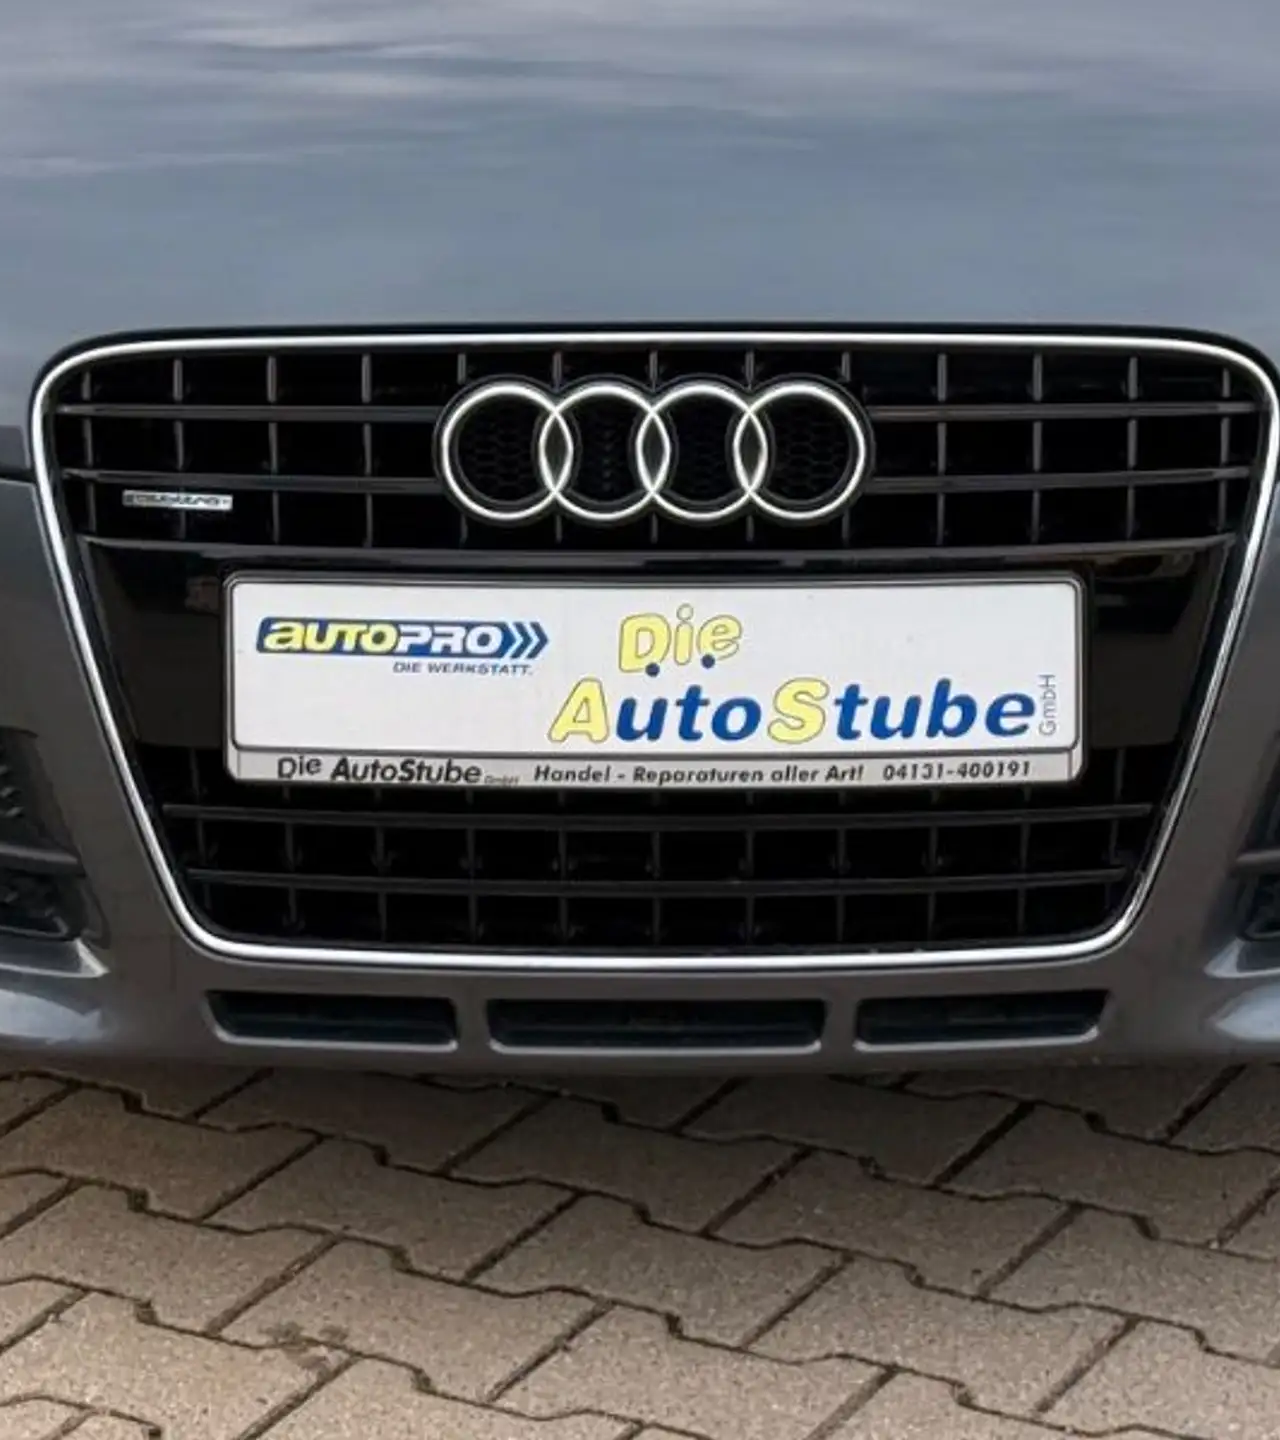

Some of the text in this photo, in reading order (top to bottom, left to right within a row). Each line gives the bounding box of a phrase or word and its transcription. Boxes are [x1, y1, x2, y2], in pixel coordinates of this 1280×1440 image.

[392, 661, 421, 674] DIE
[618, 603, 743, 674] Die
[548, 676, 1037, 745] AutoStube
[1038, 673, 1058, 737] GmbH
[277, 755, 322, 780] Die
[330, 756, 483, 785] AutoStube
[534, 764, 611, 783] Handel
[632, 765, 764, 786] Reparaturen
[770, 764, 819, 783] aller
[824, 764, 865, 782] Art!
[882, 760, 1031, 781] 04131-400191
